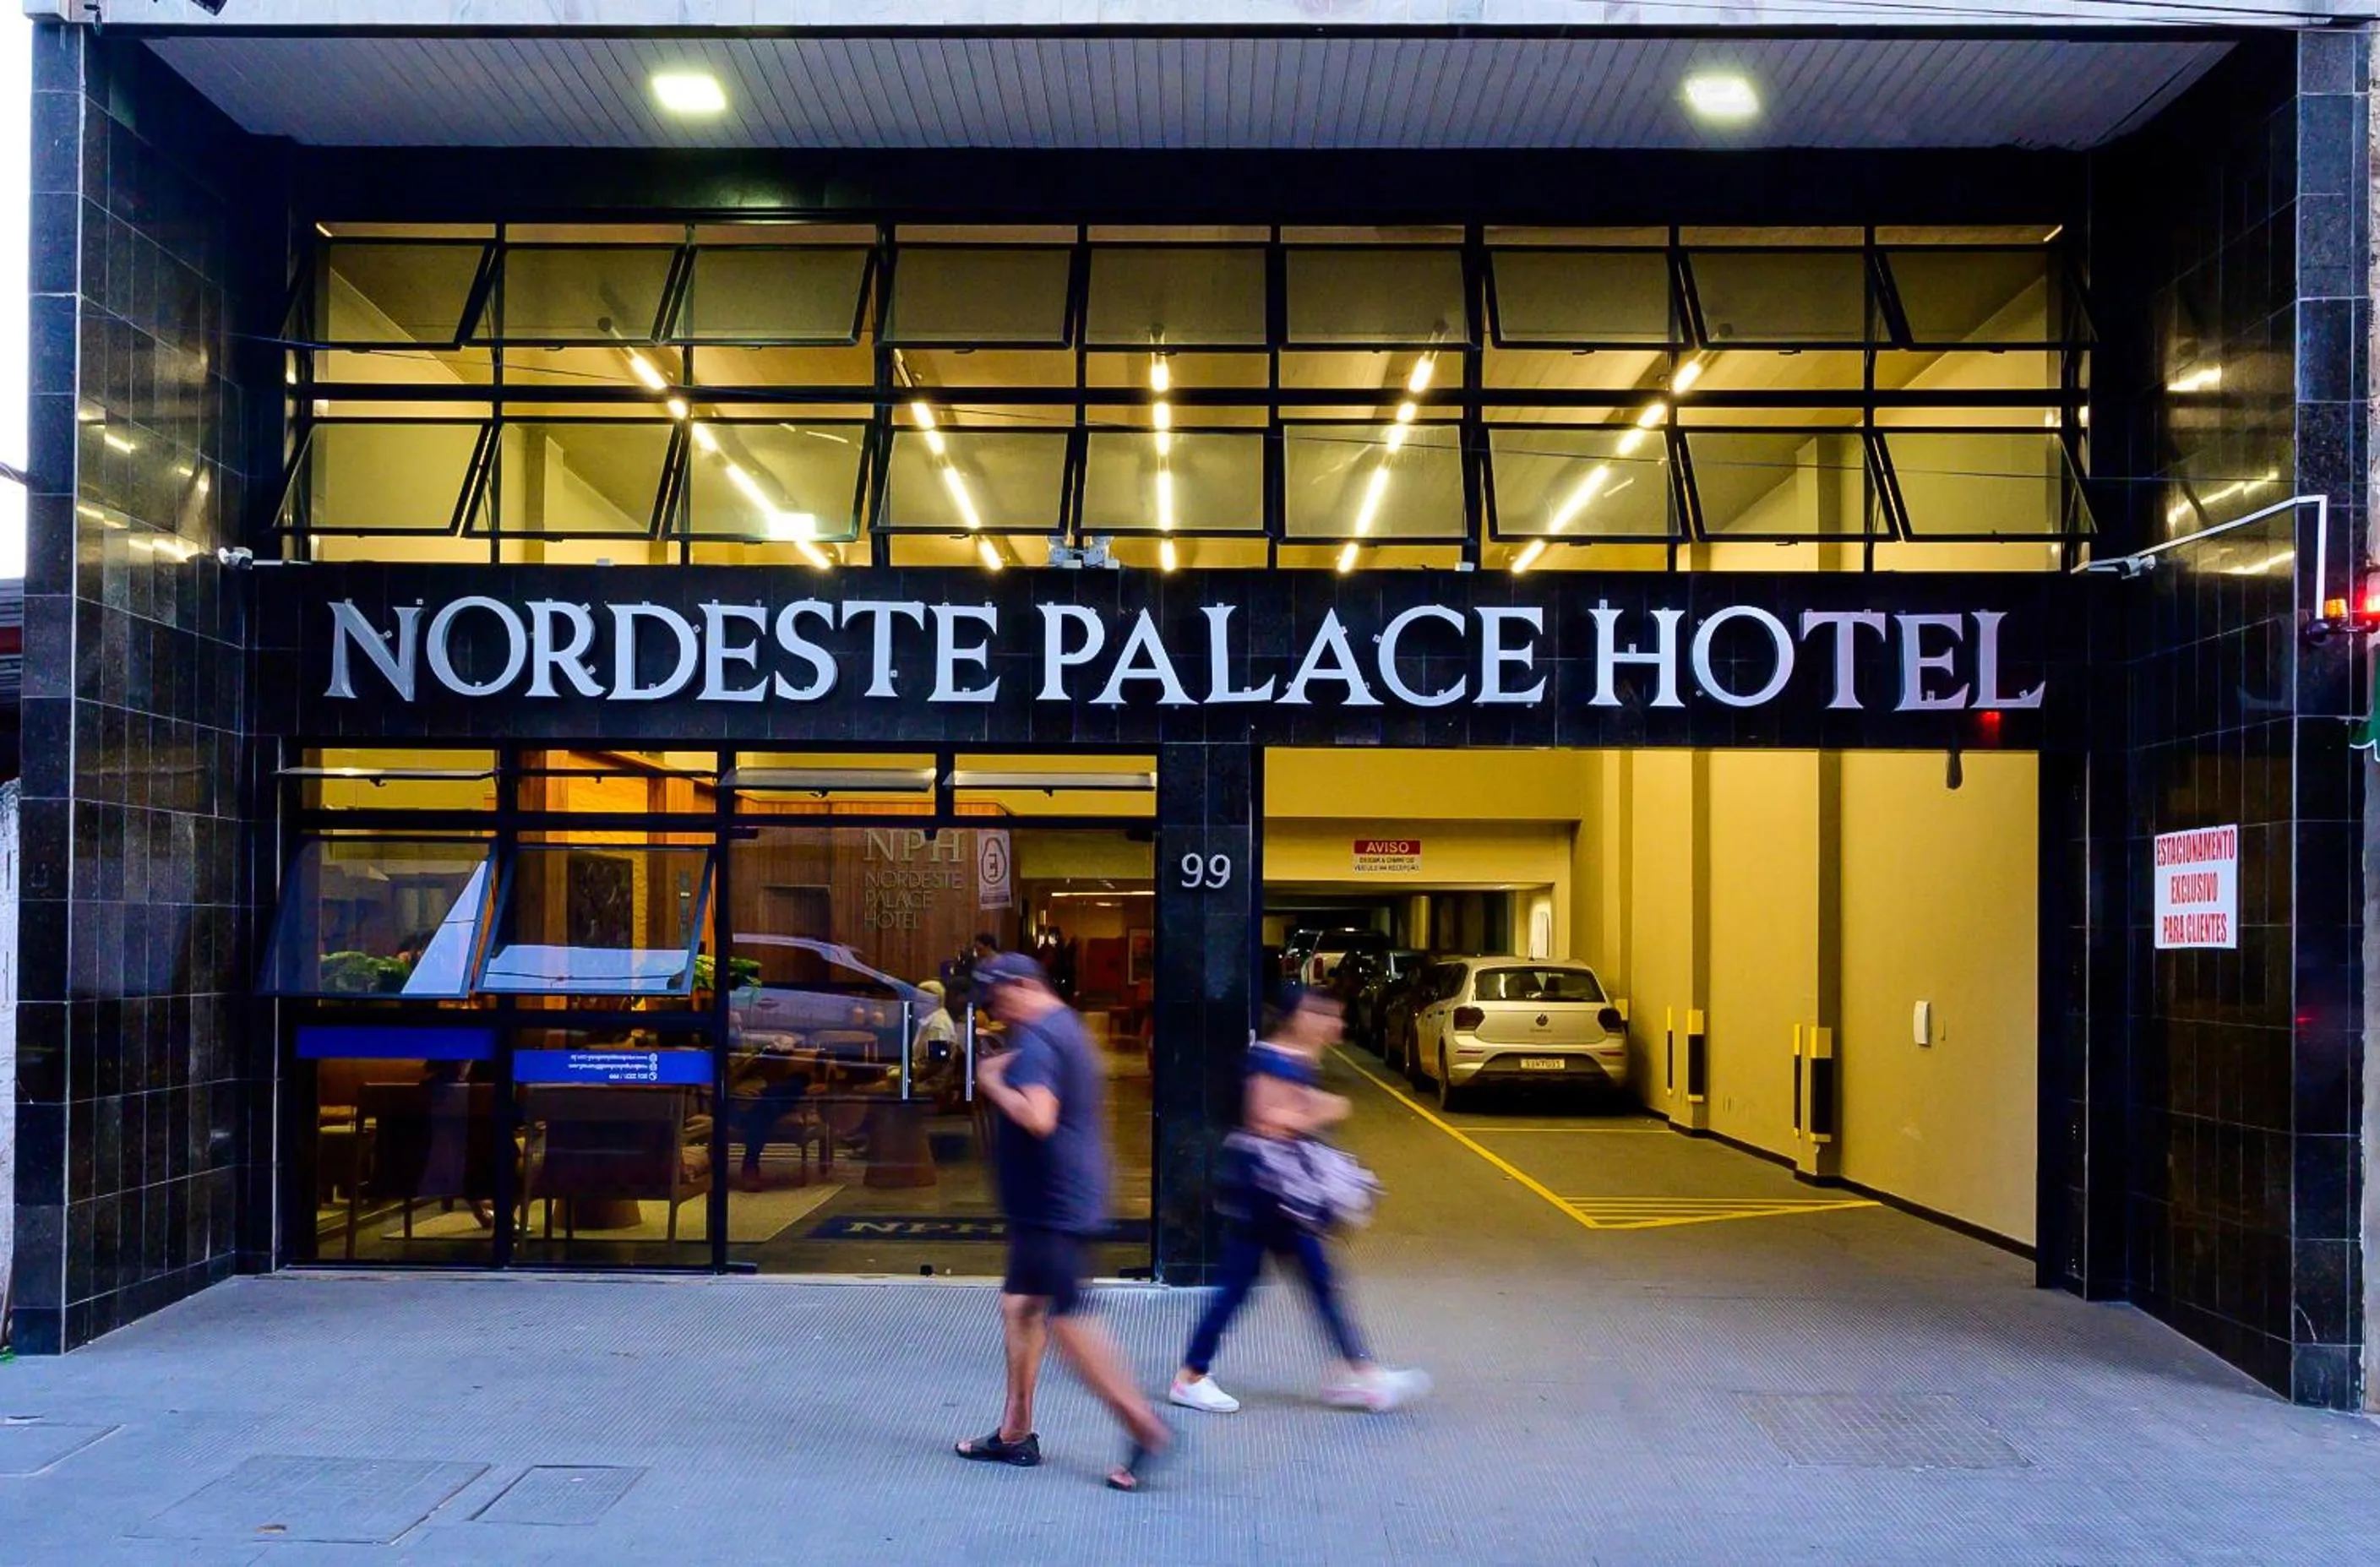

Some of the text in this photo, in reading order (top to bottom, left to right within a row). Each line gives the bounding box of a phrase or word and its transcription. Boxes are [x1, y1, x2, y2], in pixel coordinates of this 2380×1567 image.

[323, 596, 2046, 711] NORDESTE PALACE HOTEL
[863, 828, 966, 862] NPH
[1365, 841, 1409, 853] AVISO
[2156, 830, 2235, 867] ESTACIONAMENTO
[863, 870, 963, 889] NORDESTE
[1181, 852, 1231, 889] 99
[863, 890, 933, 909] PALACE
[2170, 873, 2219, 905] EXCLUSIVO
[863, 911, 920, 929] HOTEL
[2162, 913, 2227, 944] PARA CLIENTES
